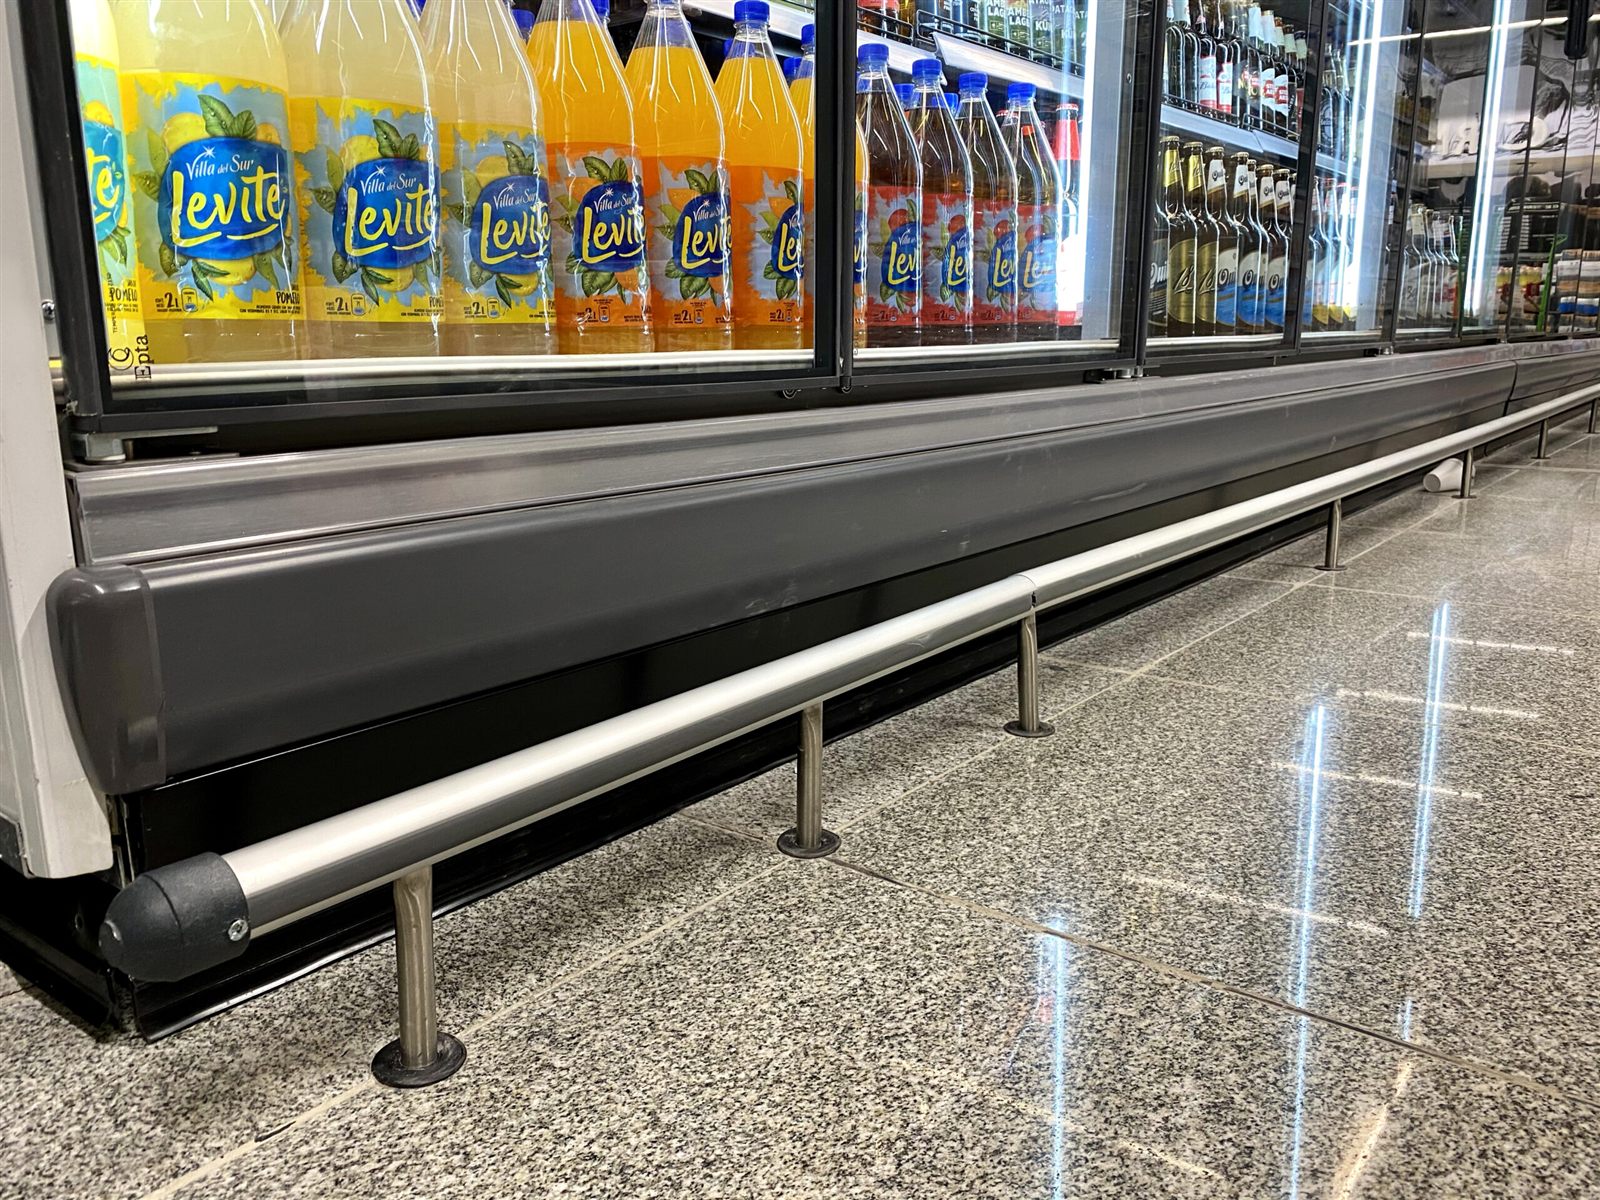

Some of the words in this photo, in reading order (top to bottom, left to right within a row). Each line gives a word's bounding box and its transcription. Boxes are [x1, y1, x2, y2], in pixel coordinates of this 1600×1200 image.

[186, 150, 215, 180] Villa
[217, 163, 229, 174] del
[229, 154, 252, 172] Sur
[360, 169, 385, 196] Villa
[396, 173, 415, 189] Sur
[493, 187, 514, 210] Villa
[593, 193, 613, 213] Villa
[134, 334, 155, 380] Epta
